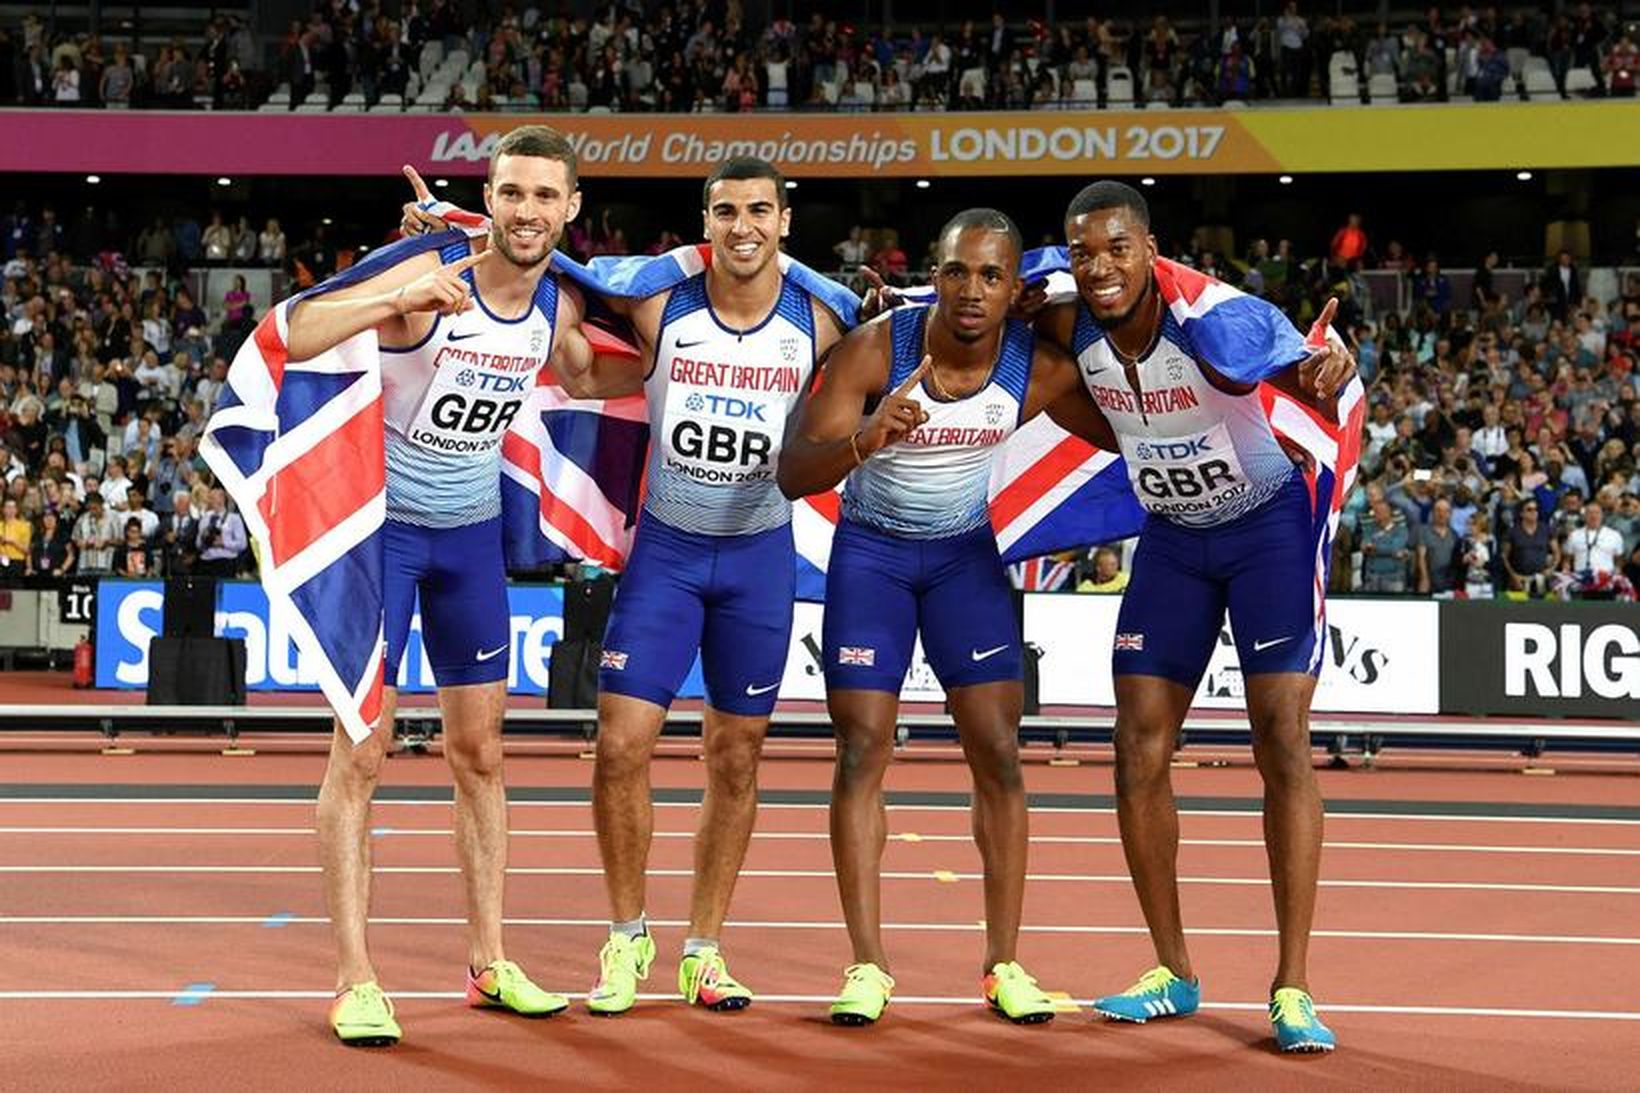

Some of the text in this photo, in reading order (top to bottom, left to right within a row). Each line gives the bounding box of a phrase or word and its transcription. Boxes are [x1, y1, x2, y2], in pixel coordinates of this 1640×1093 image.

[662, 131, 916, 169] Championships
[930, 127, 1116, 161] LONDON
[1126, 126, 1225, 160] 2017
[477, 371, 529, 393] TDK
[670, 356, 800, 393] GREAT BRITAIN
[431, 393, 523, 434] GBR
[705, 394, 767, 423] TDK
[411, 429, 479, 452] LONDON
[671, 420, 772, 467] GBR
[938, 427, 1004, 447] BRITAIN
[1150, 435, 1213, 460] TDK
[667, 457, 772, 483] LONDON 2017
[1138, 459, 1237, 499] GBR
[1145, 483, 1246, 512] LONDON 2017
[1504, 622, 1640, 699] RIG
